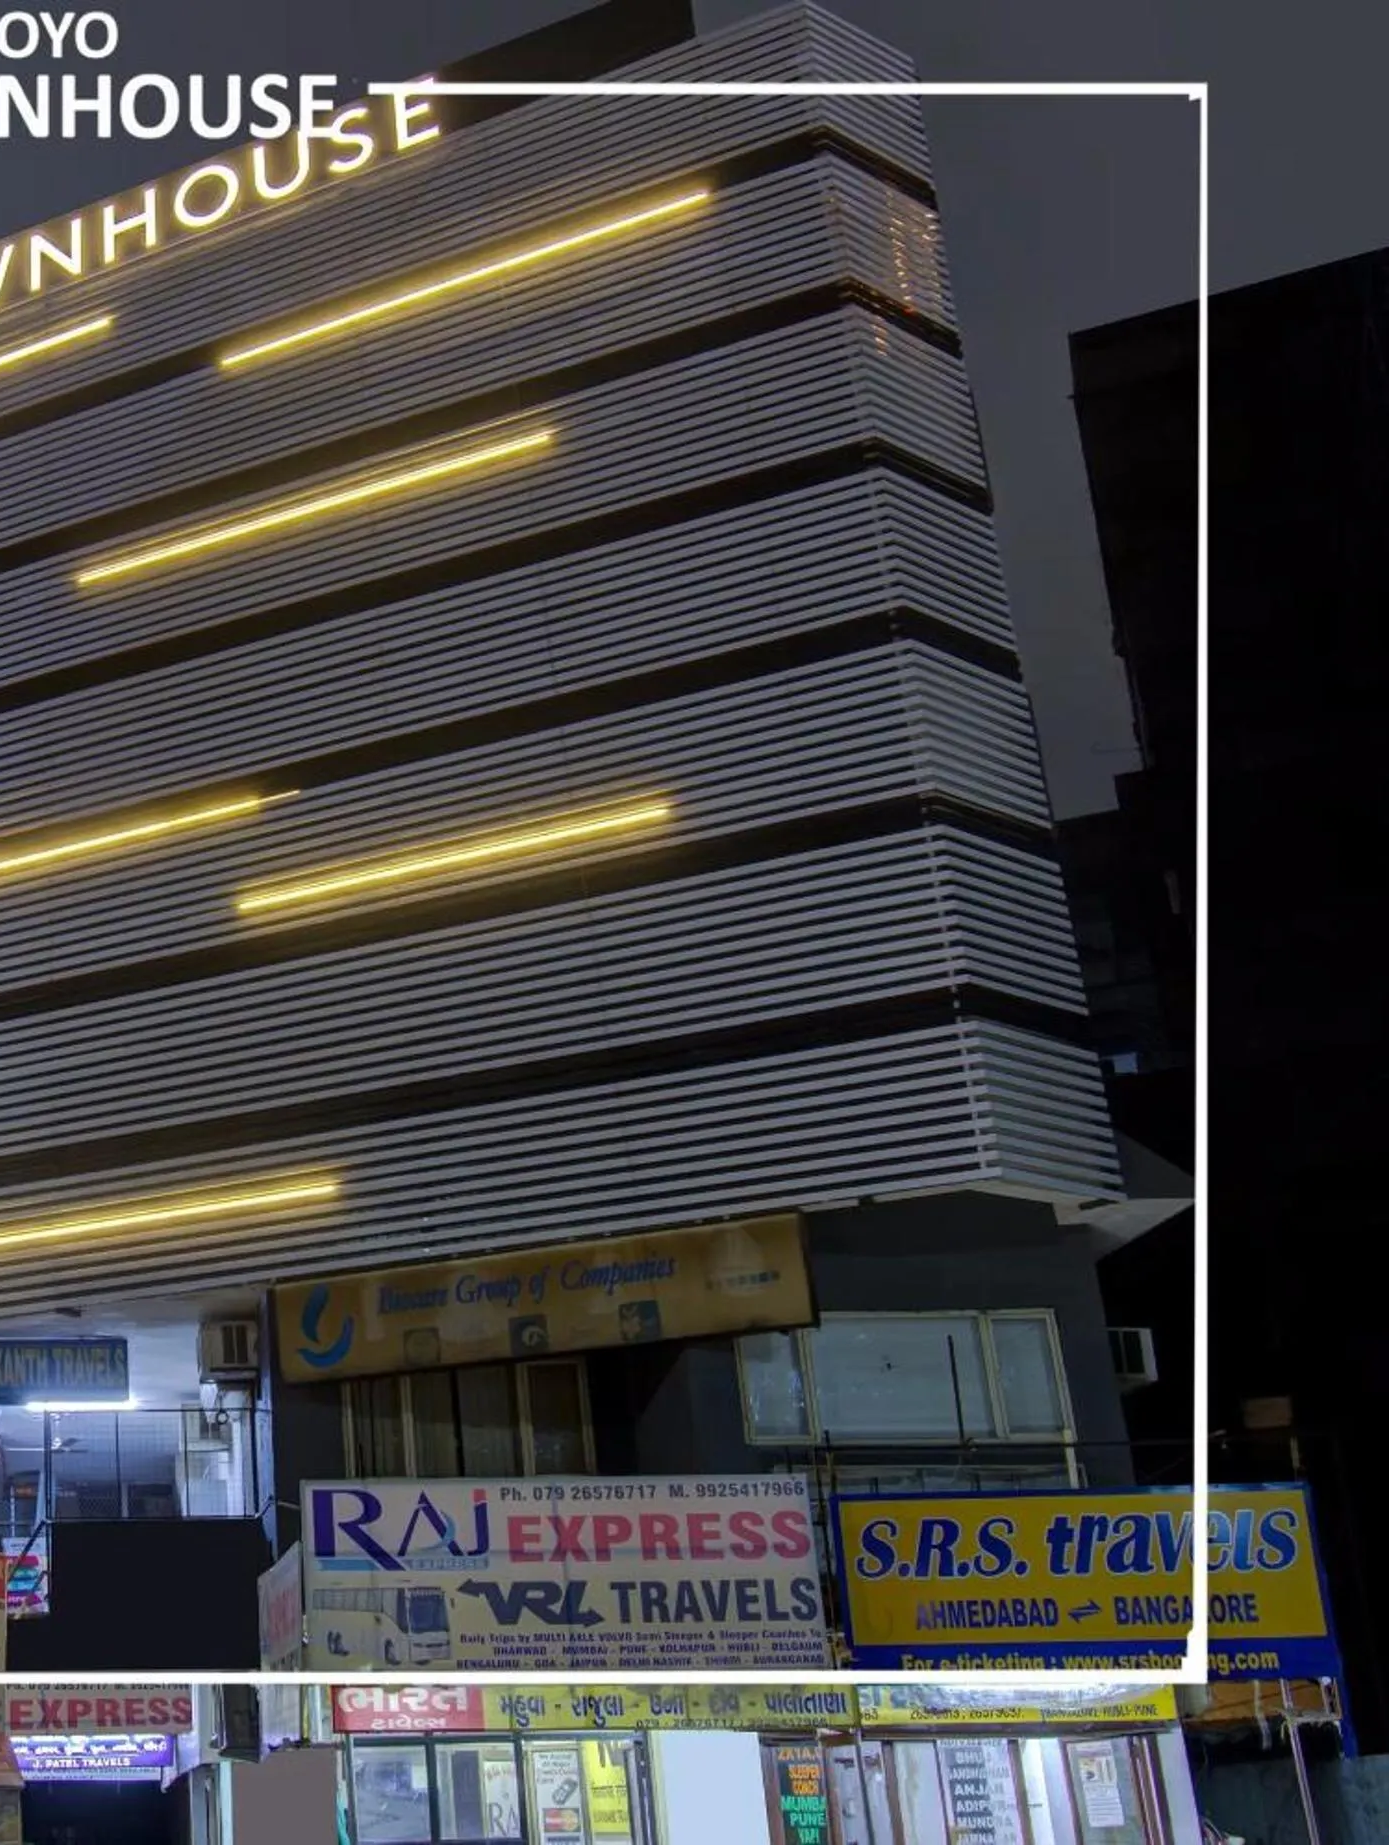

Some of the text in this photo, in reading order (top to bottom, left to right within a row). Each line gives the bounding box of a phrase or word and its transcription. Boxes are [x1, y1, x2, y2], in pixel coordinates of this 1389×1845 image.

[500, 1486, 527, 1501] Ph.
[533, 1485, 565, 1500] 079
[668, 1484, 691, 1498] M.
[507, 1510, 811, 1563] EXPRESS
[856, 1508, 1300, 1579] S.R.S. travels
[610, 1578, 820, 1624] TRAVELS
[916, 1593, 1260, 1630] AHMEDABAD BANGAORE
[10, 1699, 193, 1731] EXPRESS
